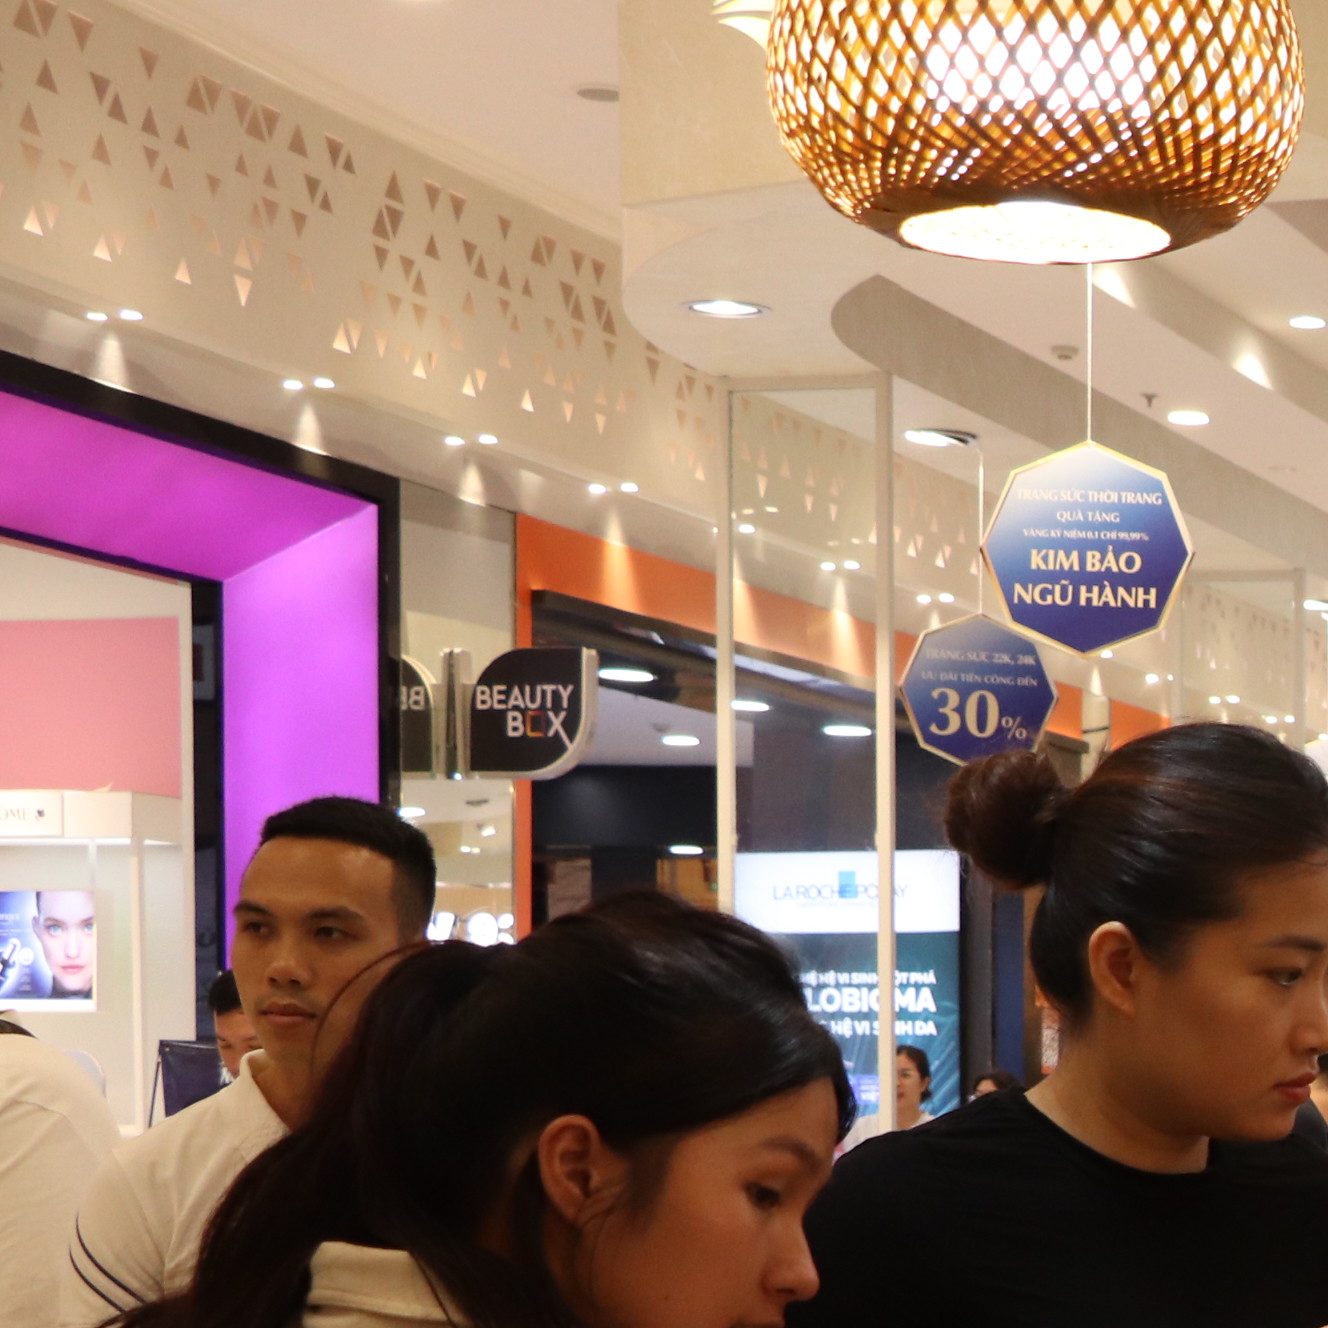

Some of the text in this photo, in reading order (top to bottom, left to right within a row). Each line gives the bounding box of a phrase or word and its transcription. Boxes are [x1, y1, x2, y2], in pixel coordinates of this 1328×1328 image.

[1016, 488, 1058, 501] TRANG
[1121, 491, 1162, 505] TRANG
[1057, 510, 1120, 524] QUÀ TẶNG
[1030, 545, 1142, 574] KIM BẢO
[1013, 580, 1157, 608] NGŨ HÀNH
[476, 684, 573, 710] BEAUTY
[929, 688, 1027, 738] 30%
[507, 711, 573, 750] BOX
[773, 885, 798, 900] LA
